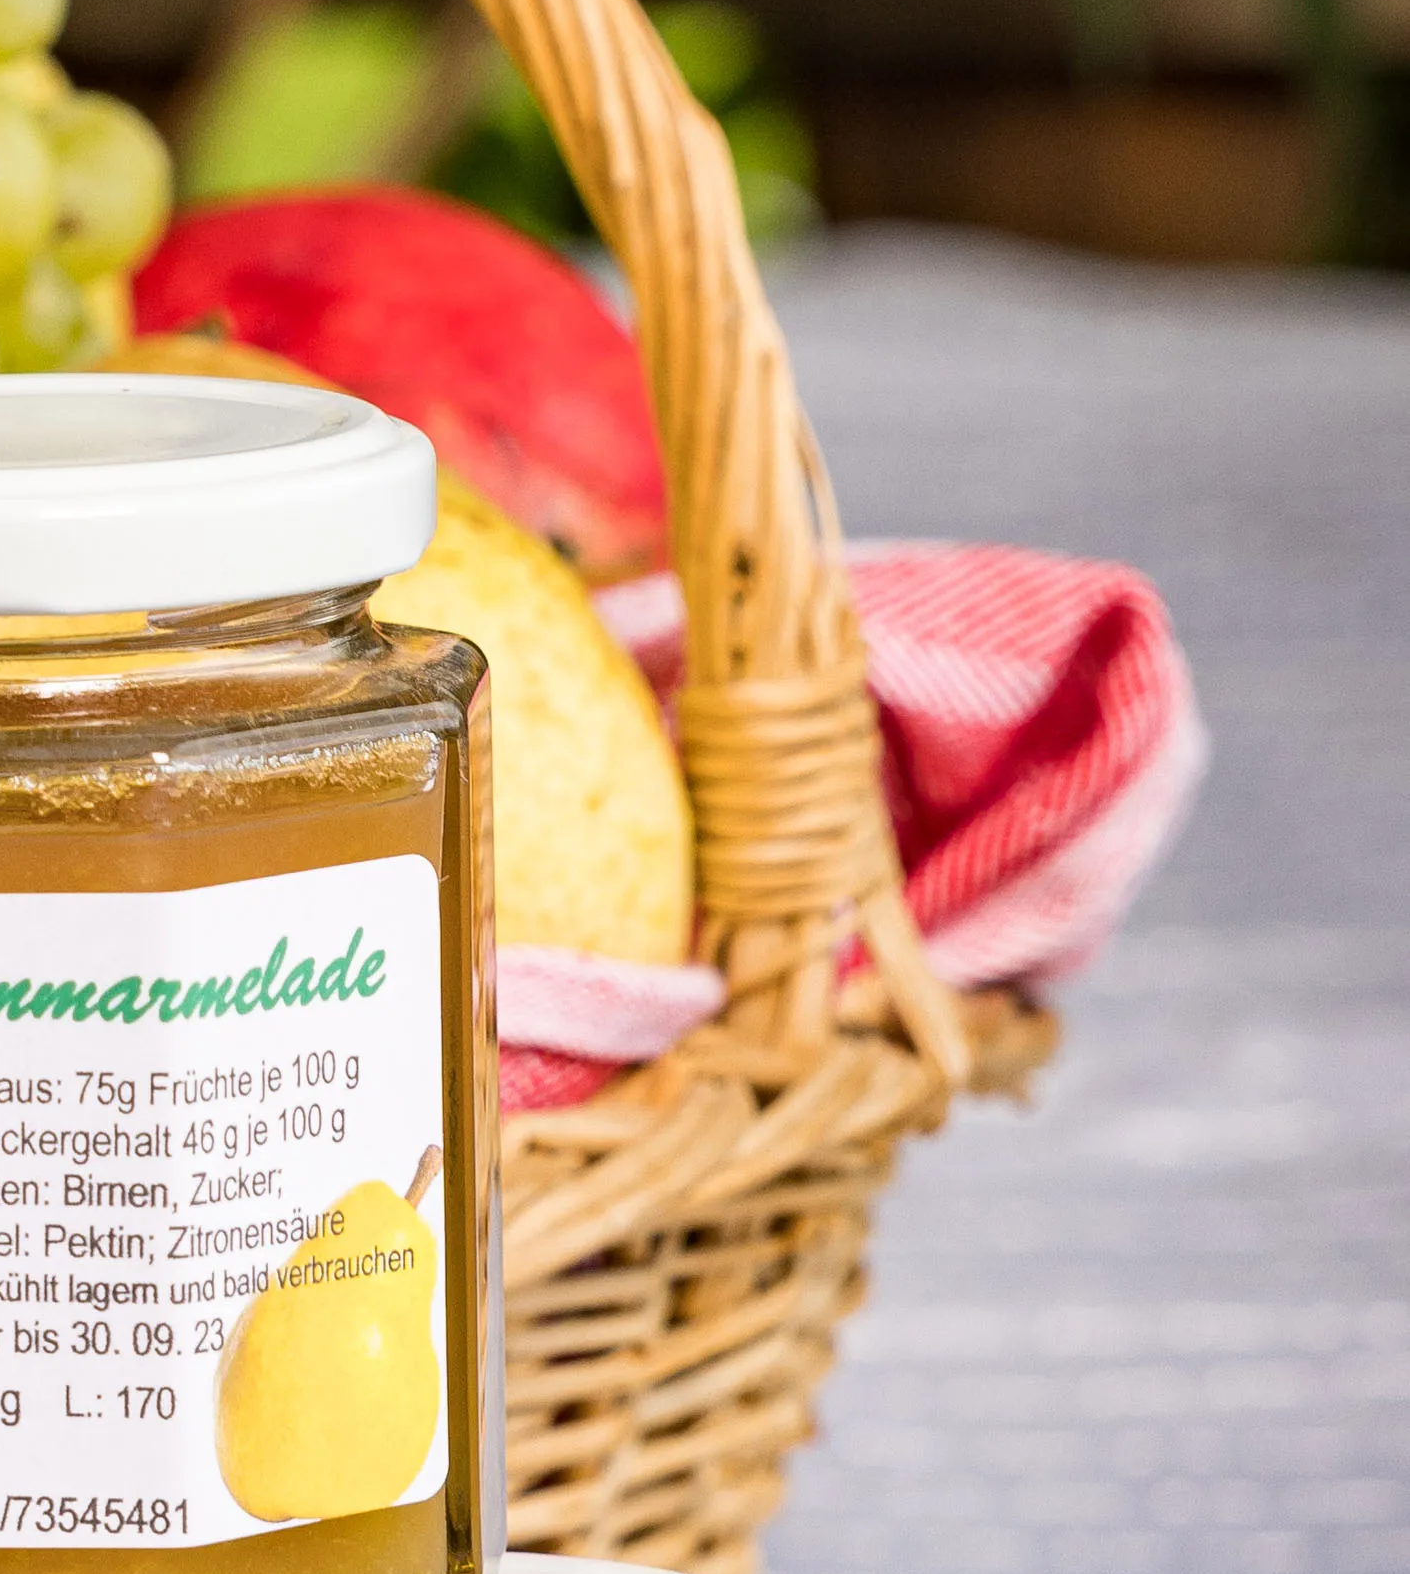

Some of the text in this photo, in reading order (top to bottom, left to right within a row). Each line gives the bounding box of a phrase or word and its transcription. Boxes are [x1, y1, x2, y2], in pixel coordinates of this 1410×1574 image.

[63, 1173, 178, 1214] Birnen,
[44, 1223, 154, 1266] Pektin;
[167, 1202, 345, 1260] Zitronensäure
[14, 1320, 60, 1355] bis
[70, 1320, 120, 1356] 30.
[132, 1322, 182, 1357] 09.
[194, 1317, 225, 1354] 23
[0, 1382, 21, 1427] g
[117, 1385, 176, 1421] 170
